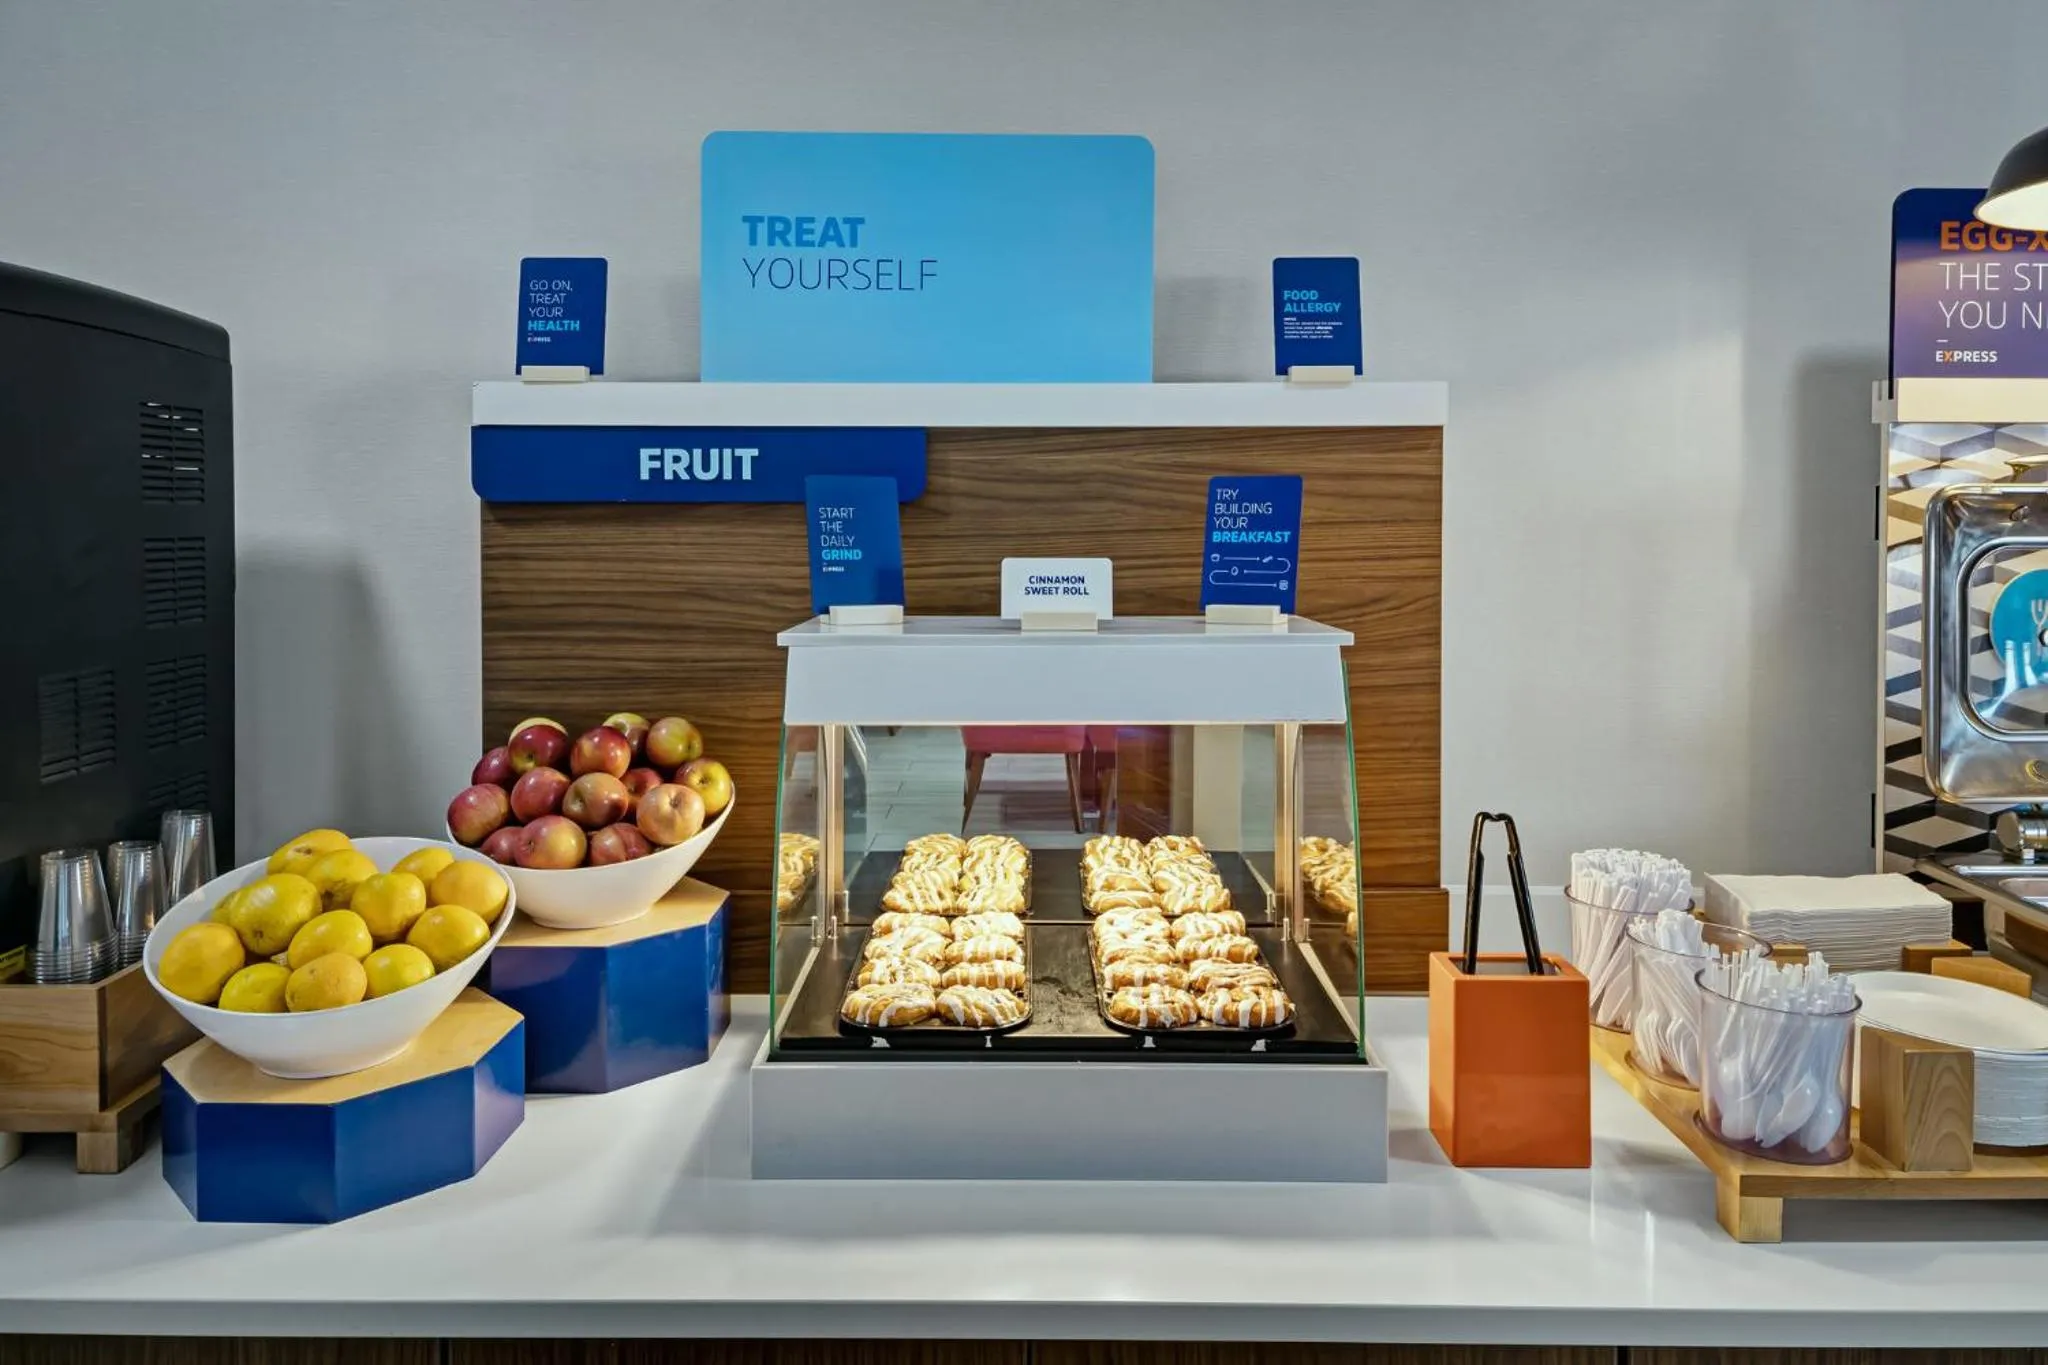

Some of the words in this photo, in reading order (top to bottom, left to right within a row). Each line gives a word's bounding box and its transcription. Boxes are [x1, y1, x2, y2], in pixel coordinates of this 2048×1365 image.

[742, 215, 866, 248] TREAT
[742, 257, 938, 291] YOURSELF
[1938, 262, 2001, 290] THE
[529, 279, 549, 291] GO
[552, 279, 573, 292] ON,
[529, 293, 567, 305] TREAT
[1283, 290, 1319, 301] FOOD
[529, 306, 564, 318] YOUR
[1283, 302, 1342, 313] ALLERGY
[1938, 300, 2007, 329] YOU
[2021, 300, 2048, 329] N
[527, 320, 580, 332] HEALTH
[1935, 350, 1998, 363] EXPRESS
[639, 447, 759, 481] FRUIT
[1216, 488, 1240, 501] TRY
[818, 507, 856, 519] START
[1214, 502, 1273, 515] BUILDING
[819, 520, 844, 533] THE
[1213, 516, 1249, 529] YOUR
[820, 534, 855, 547] DAILY
[1212, 531, 1291, 543] BREAKFAST
[821, 549, 862, 561] GRIND
[1028, 575, 1086, 585] CINNAMON
[1024, 586, 1060, 596] SWEET
[1062, 586, 1090, 596] ROLL
